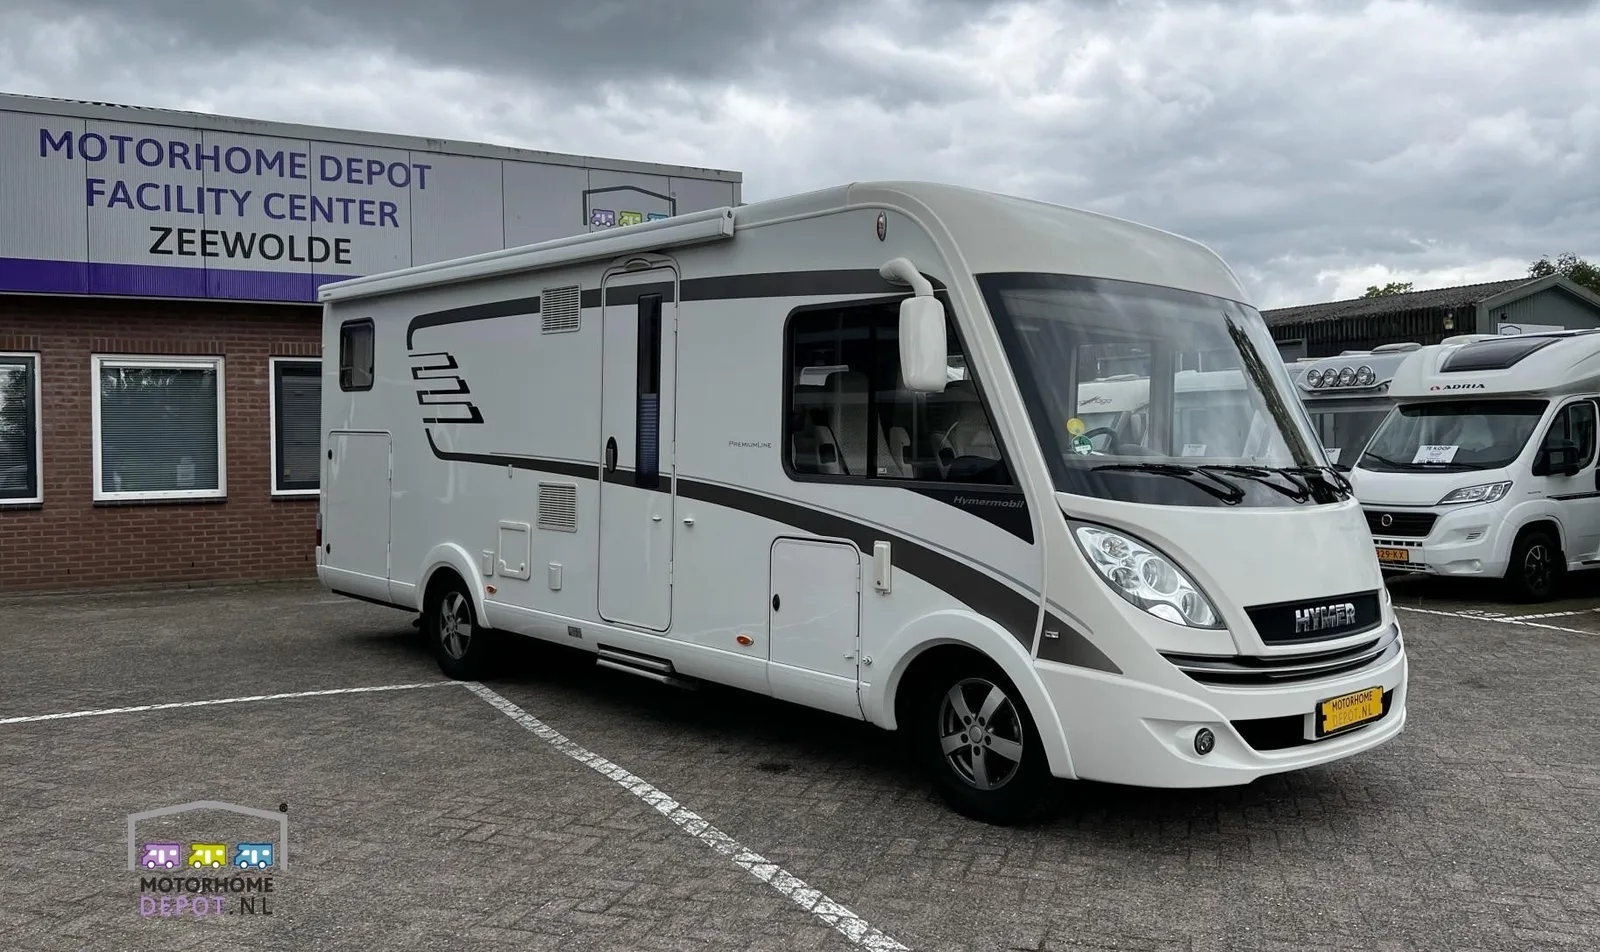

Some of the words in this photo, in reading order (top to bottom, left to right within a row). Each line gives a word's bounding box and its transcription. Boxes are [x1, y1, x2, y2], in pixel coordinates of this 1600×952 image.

[39, 128, 308, 180] MOTORHOME
[319, 154, 432, 190] DEPOT
[86, 178, 252, 217] FACILITY
[263, 192, 400, 228] CENTER
[149, 226, 352, 265] ZEEWOLDE
[953, 495, 1025, 508] Hymermobil
[1295, 602, 1356, 633] HYMER
[1332, 691, 1373, 712] MOTORHOME
[1332, 704, 1373, 727] DEPOT.NL
